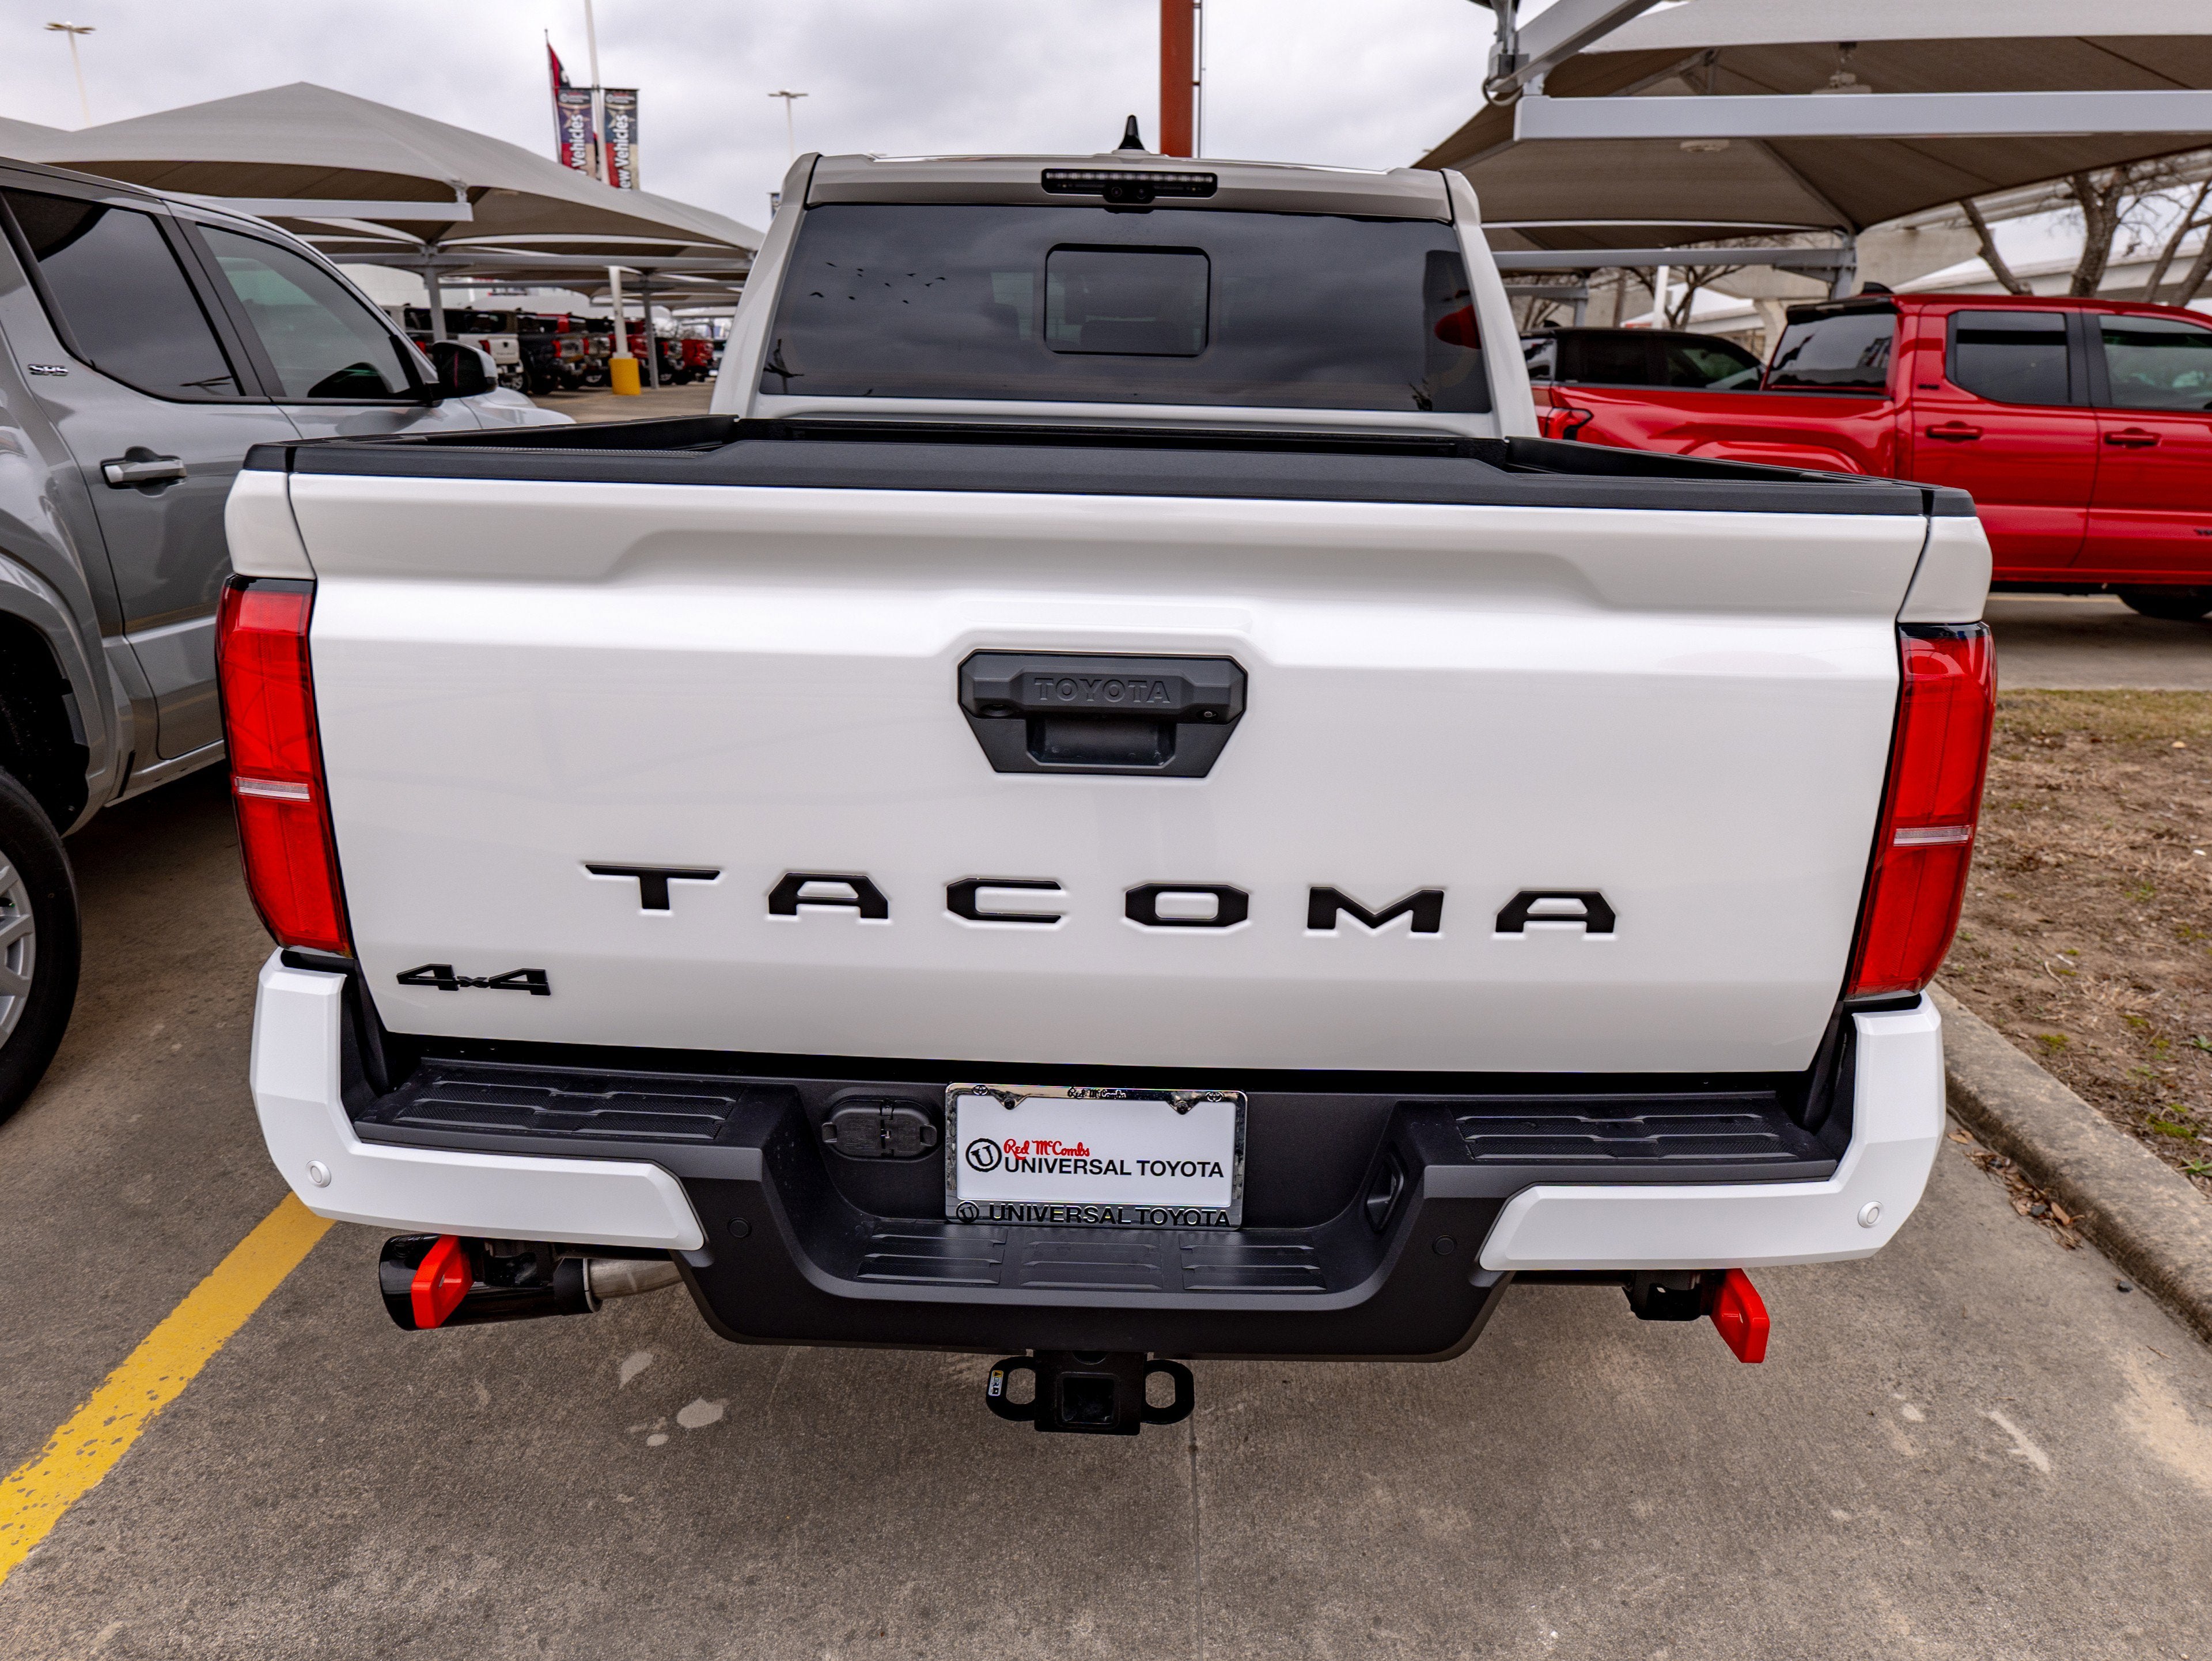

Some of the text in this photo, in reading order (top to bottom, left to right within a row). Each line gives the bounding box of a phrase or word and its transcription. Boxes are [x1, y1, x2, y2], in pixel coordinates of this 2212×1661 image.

[568, 114, 586, 168] Vehicles
[612, 114, 630, 168] Vehicles
[1035, 678, 1171, 704] TOYOTA
[585, 864, 1616, 933] TACOMA
[396, 963, 551, 996] 4x4
[1003, 1138, 1090, 1160] Red McCombs
[1005, 1157, 1224, 1178] UNIVERSAL TOYOTA
[989, 1203, 1232, 1227] UNIVERSAL TOYOTA
